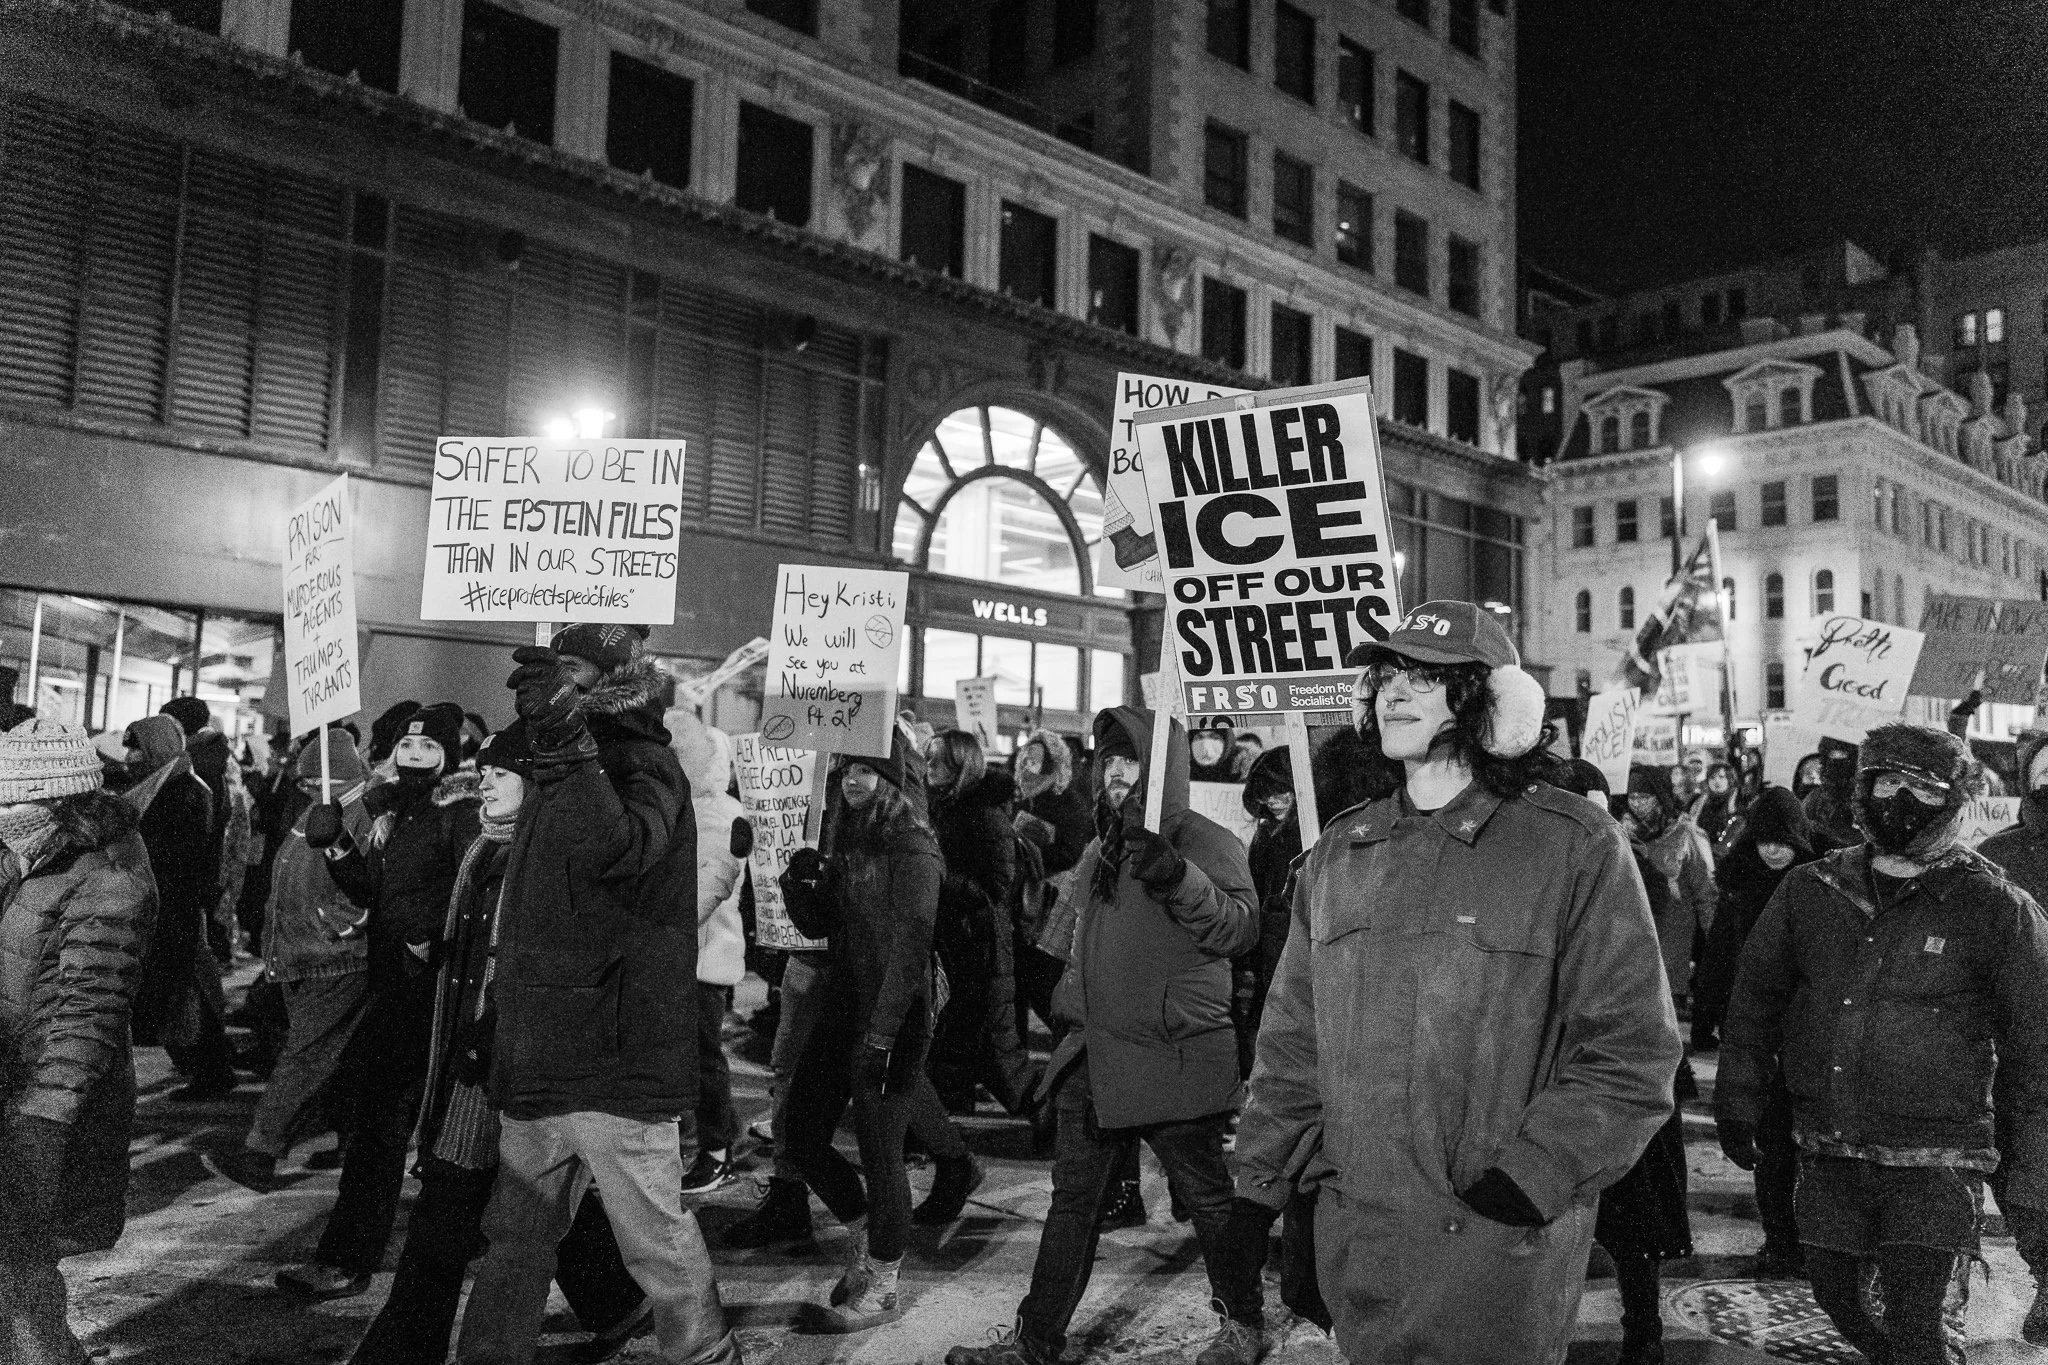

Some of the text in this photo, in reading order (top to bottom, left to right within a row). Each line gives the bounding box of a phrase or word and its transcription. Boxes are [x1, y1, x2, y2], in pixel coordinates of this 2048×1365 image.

[1125, 379, 1189, 408] HOW
[1119, 418, 1134, 442] T
[435, 440, 683, 485] SAFER TO BE IN
[1113, 448, 1144, 475] BO
[1162, 403, 1348, 498] KILLER
[288, 491, 342, 561] PRISON
[434, 496, 679, 540] THE EPSTEIN FILES
[1158, 480, 1379, 569] ICE
[432, 541, 677, 579] THAN IN OUR STREETS
[286, 564, 342, 619] MURDEROUS
[784, 572, 896, 618] Hey Kristi,
[1173, 562, 1386, 604] OFF OUR
[302, 590, 343, 639] AGENTS
[972, 598, 1048, 627] WELLS
[1396, 614, 1451, 636] SO
[784, 623, 808, 647] We
[824, 626, 856, 649] will
[1176, 595, 1391, 677] STREETS
[294, 639, 343, 686] TRUMP'S
[816, 658, 839, 679] you
[849, 660, 867, 675] at
[302, 659, 352, 715] TYRANTS
[781, 670, 863, 718] Nuremberg
[1288, 682, 1353, 695] Freedom Ro
[1819, 662, 1888, 700] Good
[807, 704, 827, 727] Pt.
[1290, 694, 1353, 707] Socialist Org
[736, 738, 755, 763] ALEX
[761, 764, 803, 790] GOOD
[773, 794, 811, 811] DOMINGUE
[782, 811, 806, 829] DIA
[780, 829, 797, 847] LA
